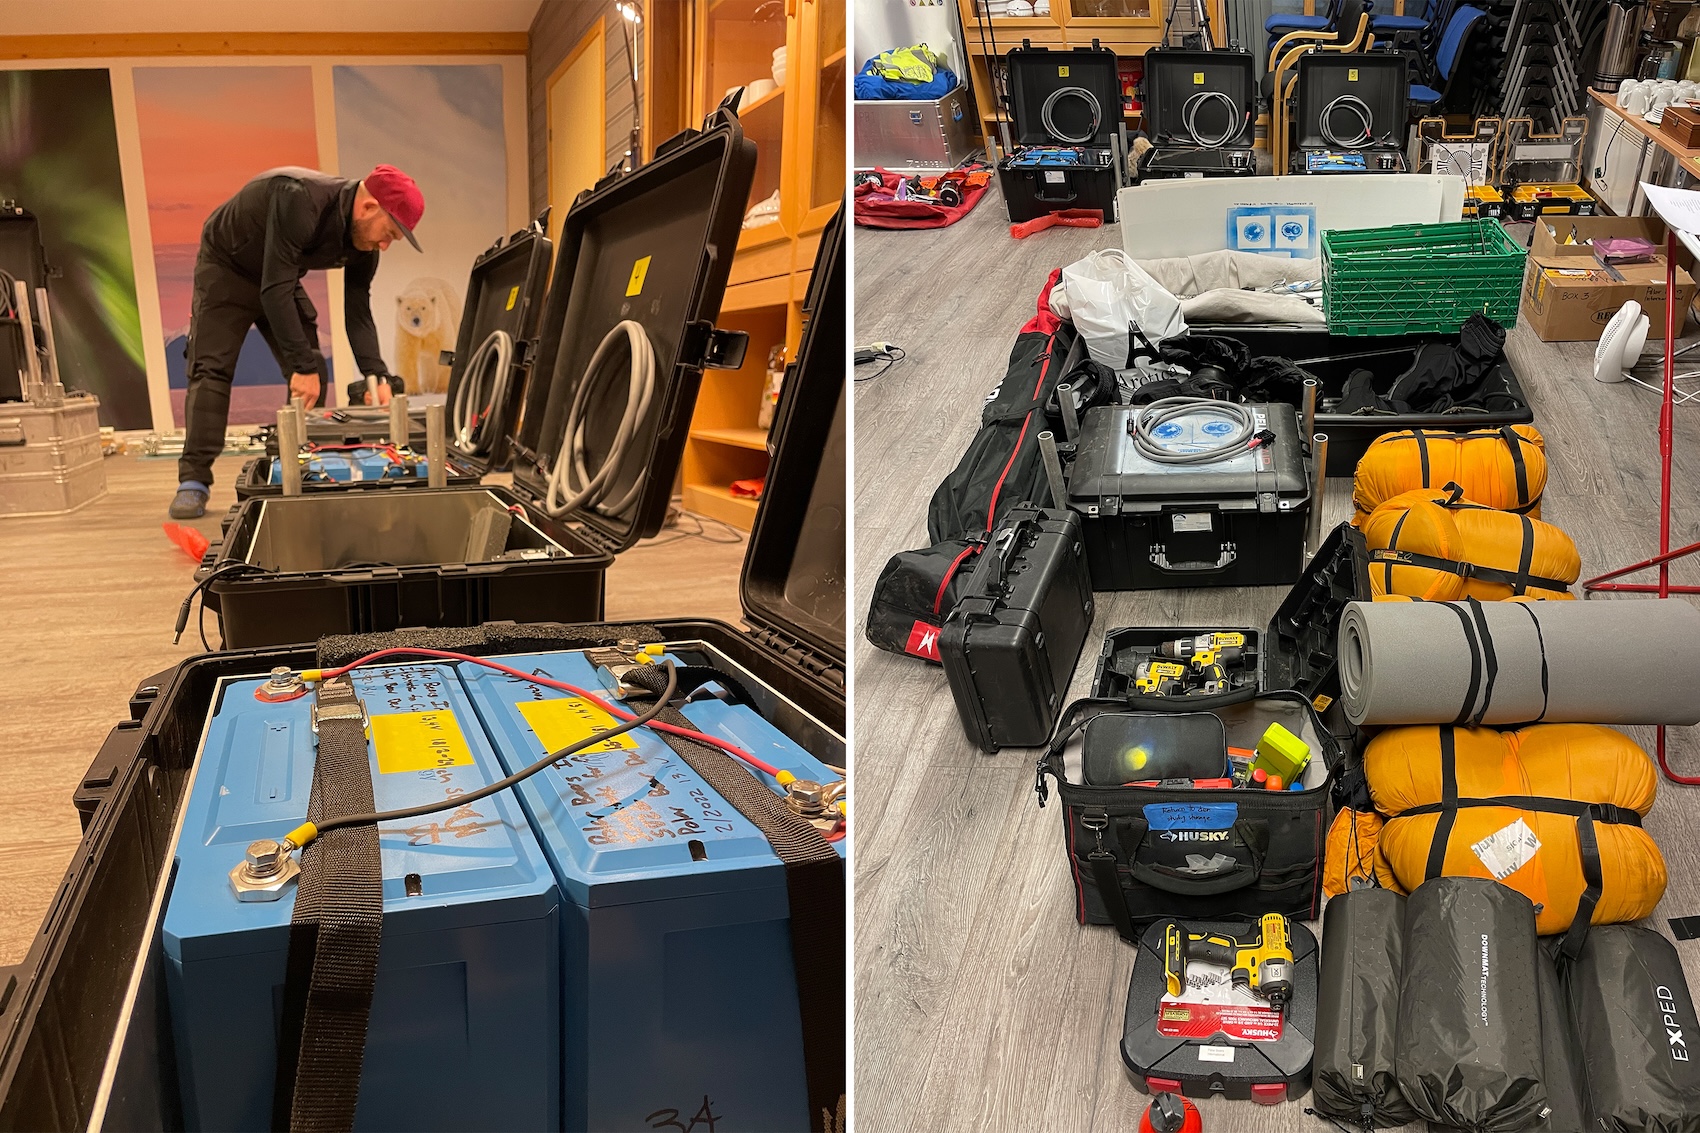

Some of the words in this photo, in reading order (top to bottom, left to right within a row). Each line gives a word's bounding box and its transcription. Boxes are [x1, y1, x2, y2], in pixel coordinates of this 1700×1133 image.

[1561, 291, 1579, 301] BOX
[1581, 292, 1590, 301] 3
[1179, 831, 1229, 842] HUSKY
[1481, 934, 1489, 977] DOWNMAT
[1656, 985, 1689, 1061] EXPED
